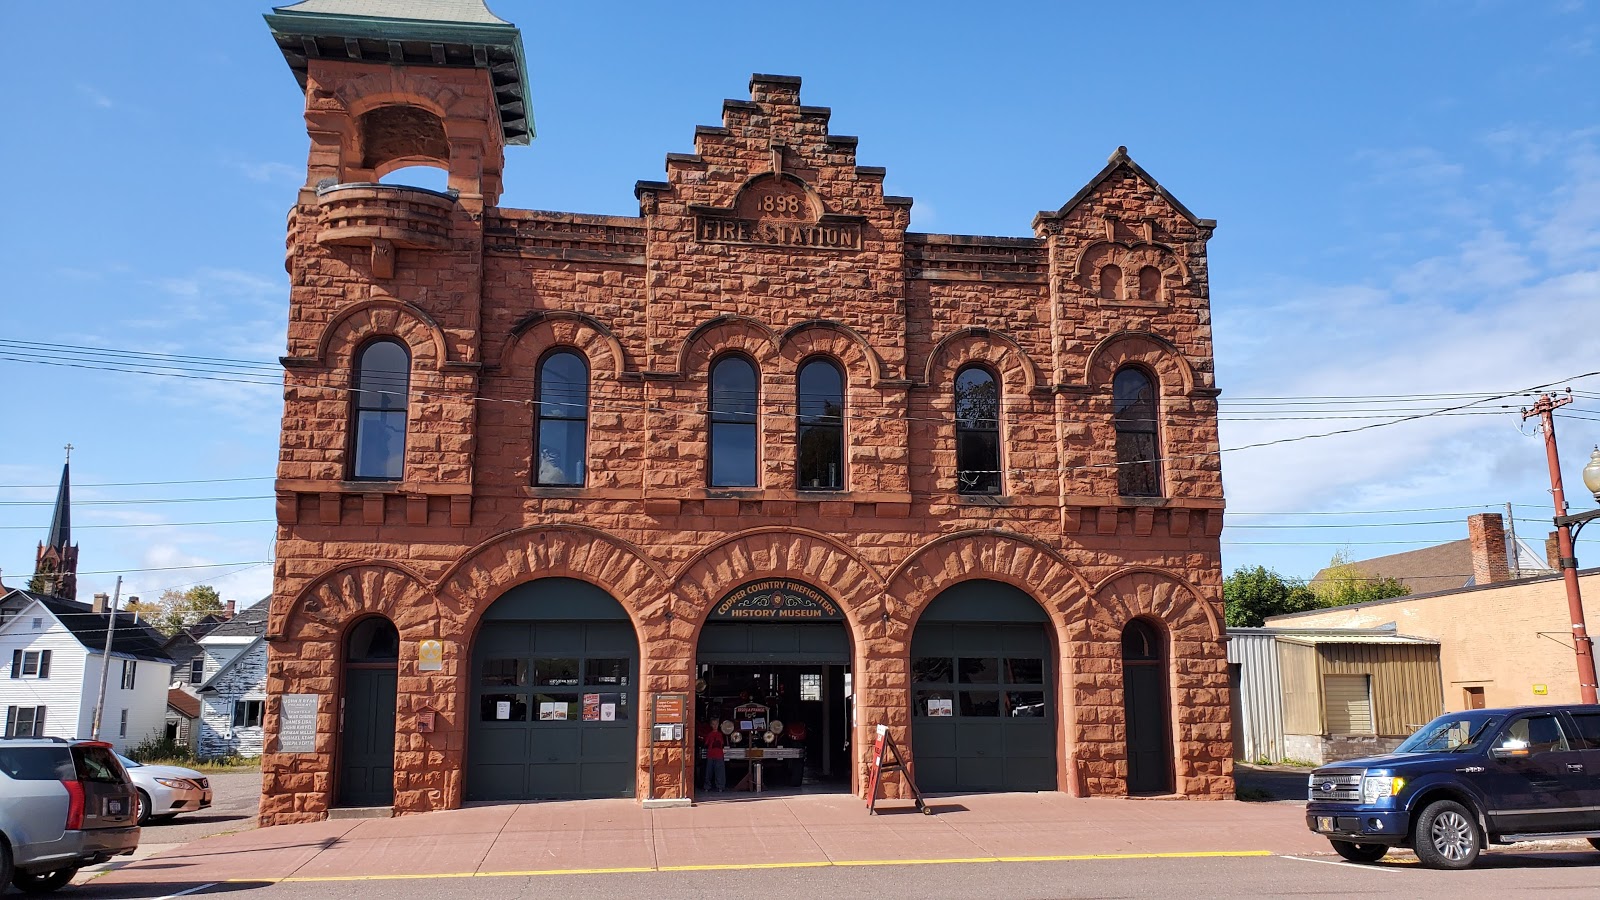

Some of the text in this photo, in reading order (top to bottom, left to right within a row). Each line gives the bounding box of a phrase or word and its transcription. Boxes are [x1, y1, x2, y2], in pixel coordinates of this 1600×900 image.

[757, 195, 799, 213] 1898
[703, 220, 852, 246] FIRE STATION
[718, 580, 837, 616] COPPER COUNTRY FIREFIGHTERS
[731, 609, 822, 617] HISTORY MUSEUM
